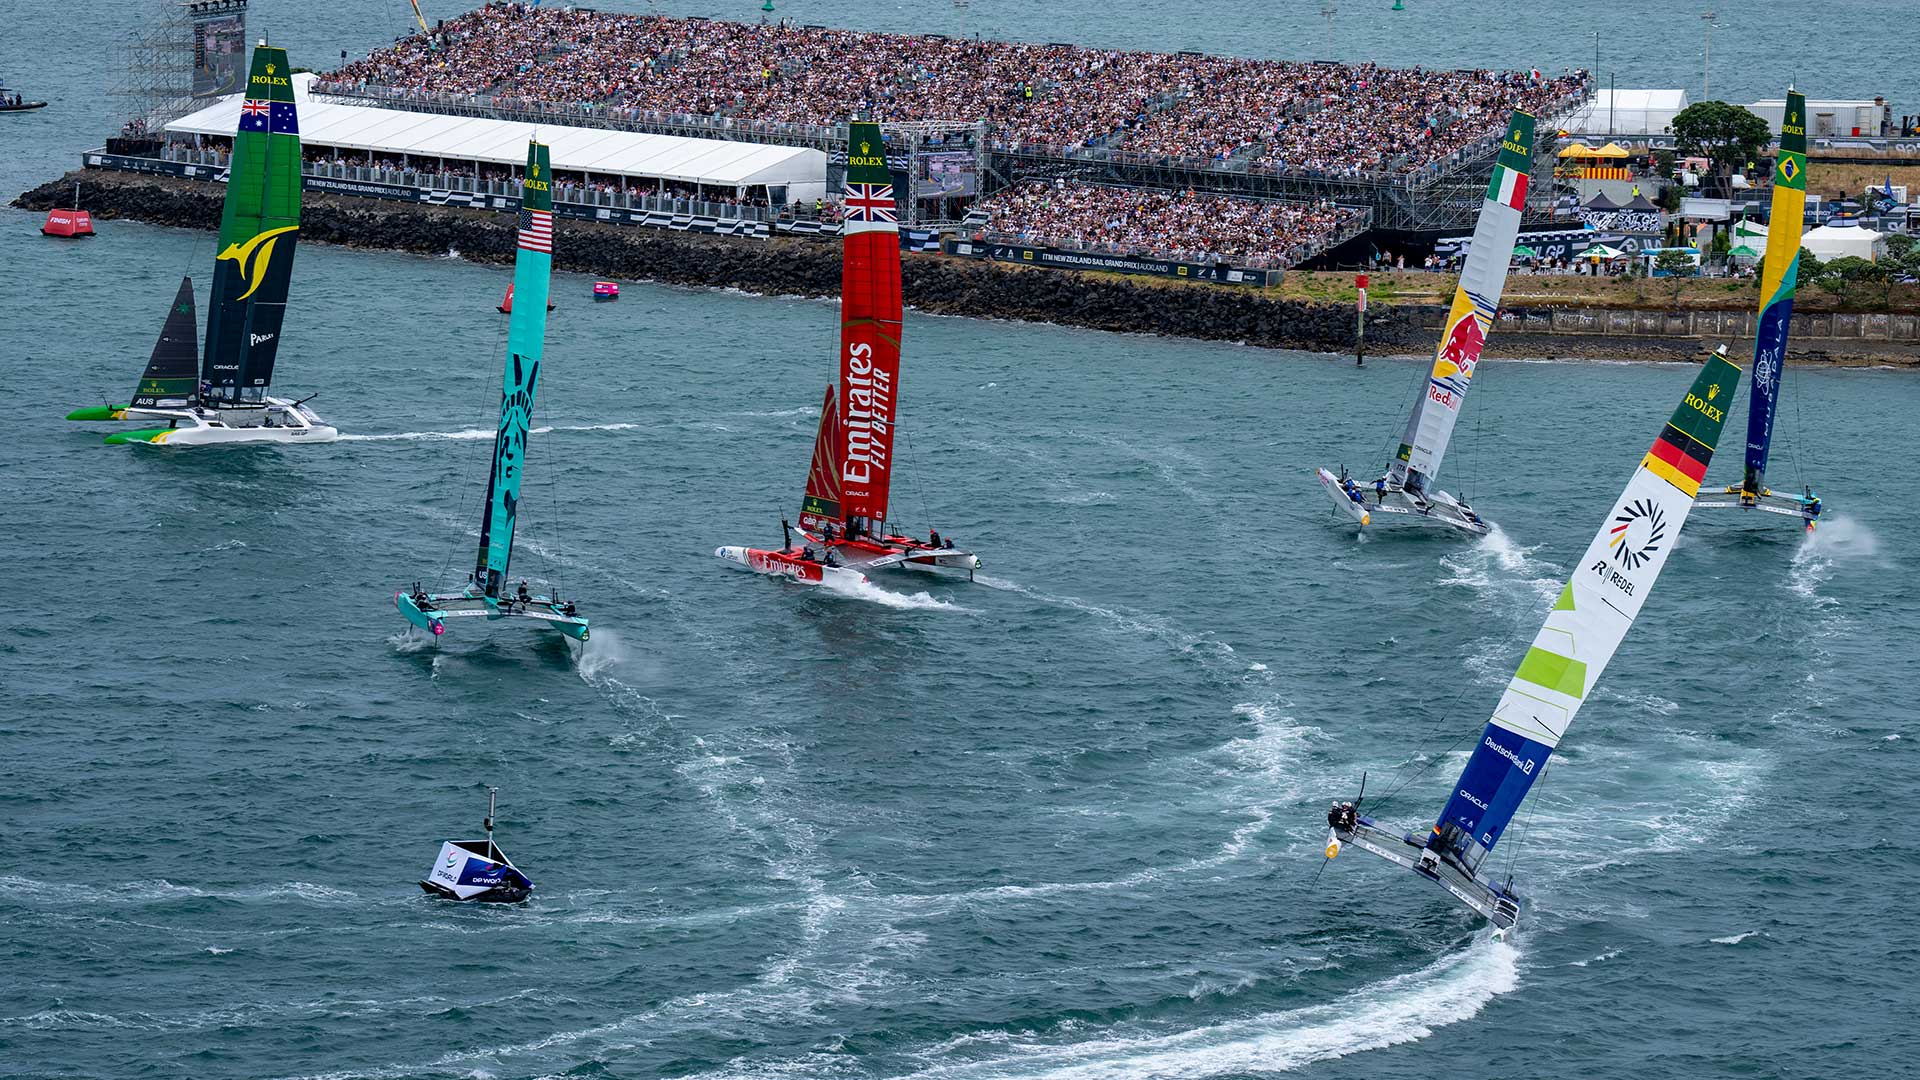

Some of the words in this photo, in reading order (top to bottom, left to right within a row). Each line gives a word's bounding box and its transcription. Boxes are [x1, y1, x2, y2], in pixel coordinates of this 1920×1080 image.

[252, 75, 288, 86] ROLEX
[1781, 124, 1804, 136] ROLEX
[1502, 139, 1528, 156] ROLEX
[849, 156, 883, 166] ROLEX
[326, 181, 348, 190] ZEALAND
[358, 185, 374, 193] GRAND
[523, 178, 548, 191] ROLEX
[50, 216, 72, 225] FINISH
[1043, 253, 1054, 261] ITM
[1054, 254, 1066, 262] NEW
[1066, 254, 1092, 264] ZEALAND
[1092, 256, 1104, 266] SAIL
[1105, 259, 1123, 268] GRAND
[1123, 260, 1137, 269] PRIX
[1139, 262, 1168, 272] AUCKLAND
[1764, 318, 1783, 436] MUBADALA
[136, 398, 154, 406] AUS
[871, 367, 890, 436] BETTER
[1429, 384, 1452, 407] Red
[843, 342, 872, 484] Emirates
[1684, 392, 1724, 422] ROLEX
[870, 436, 886, 470] FLY
[763, 555, 806, 578] Emirates
[1610, 571, 1635, 597] REDEL
[1460, 789, 1488, 810] ORACLE
